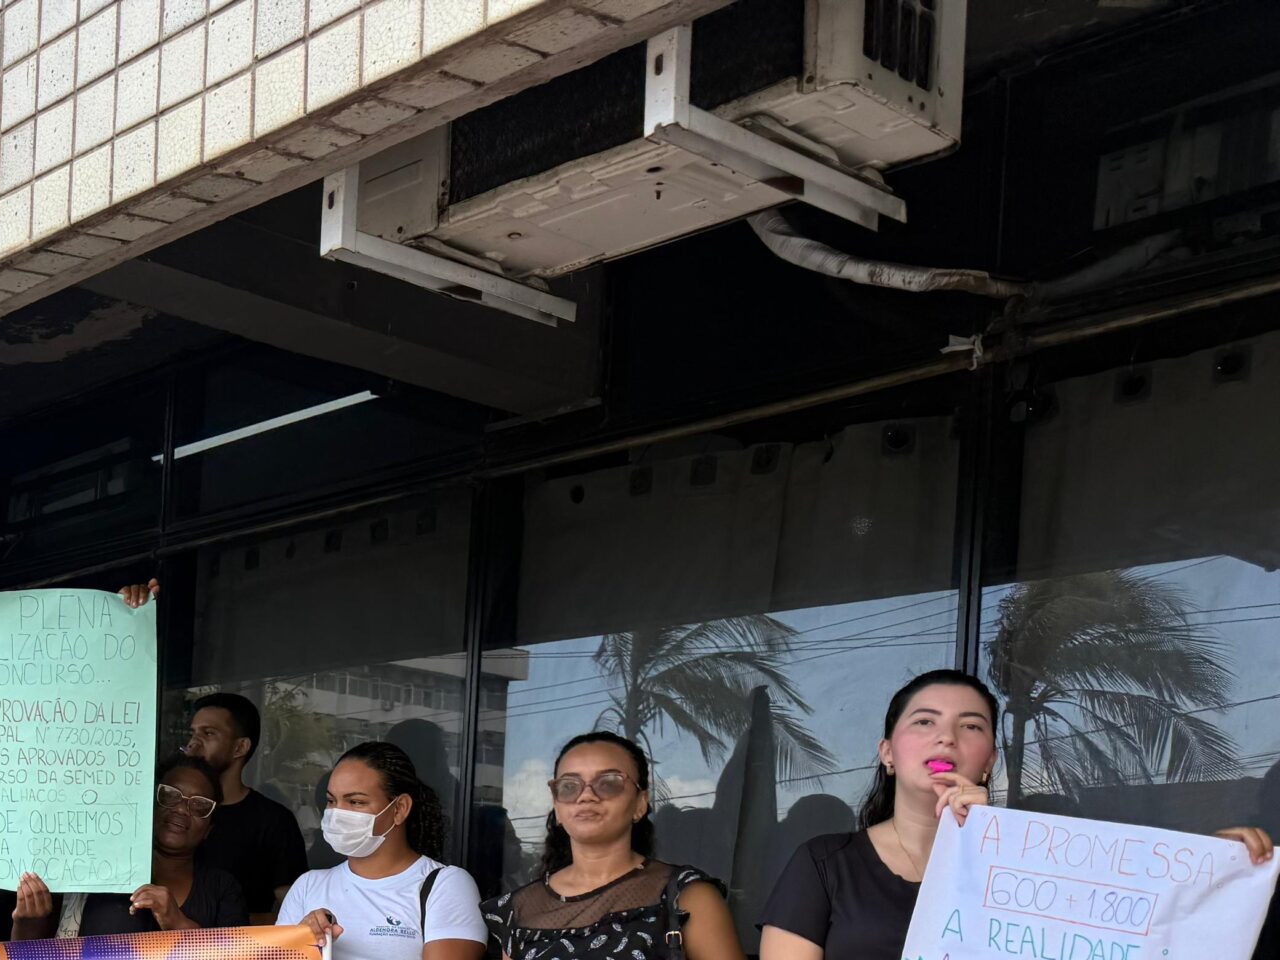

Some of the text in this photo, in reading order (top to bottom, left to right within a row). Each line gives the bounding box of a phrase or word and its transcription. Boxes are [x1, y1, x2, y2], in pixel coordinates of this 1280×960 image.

[20, 594, 113, 630] PLENA
[104, 633, 136, 661] DO
[17, 748, 106, 766] APROVADOS
[118, 750, 141, 767] DO
[37, 769, 58, 784] DA
[63, 770, 116, 785] SEMED
[124, 770, 143, 785] DE
[29, 809, 123, 836] QUEREMOS
[27, 837, 95, 856] GRANDE
[991, 871, 1151, 927] 600 + 1.800
[941, 908, 964, 942] A
